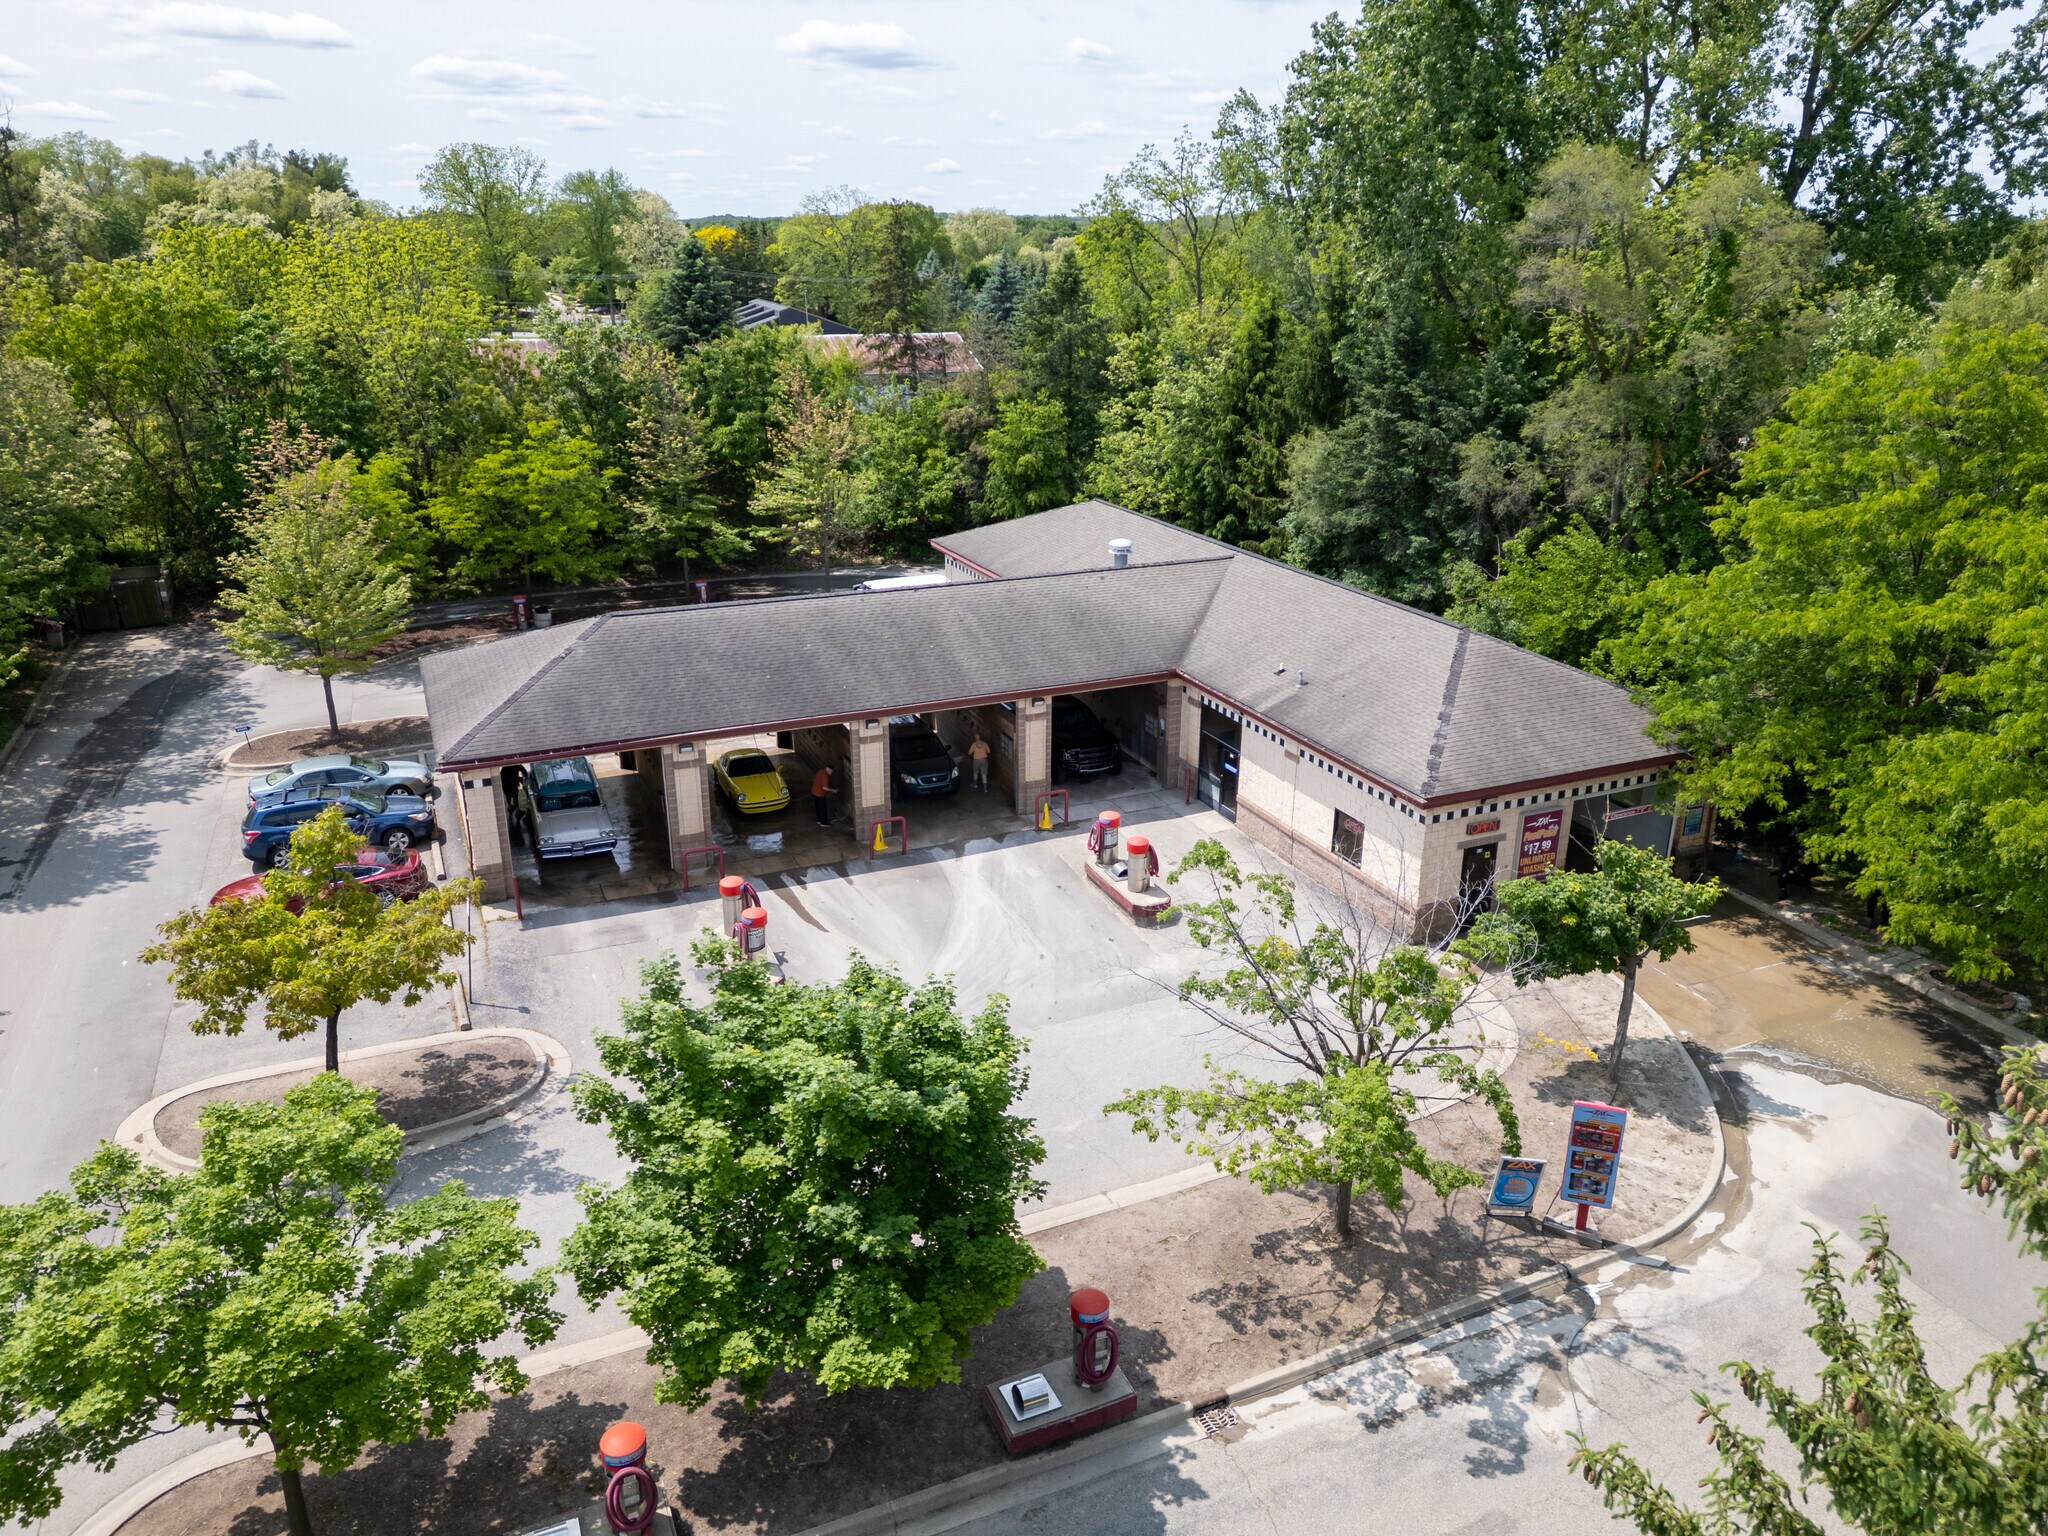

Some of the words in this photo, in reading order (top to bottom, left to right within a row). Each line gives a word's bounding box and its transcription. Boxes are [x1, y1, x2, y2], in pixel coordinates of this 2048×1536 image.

[1344, 818, 1364, 834] OPEN
[1471, 820, 1497, 835] OPEN
[1524, 840, 1551, 855] $17.99
[1520, 852, 1555, 867] UNLIMITED
[1523, 862, 1547, 874] WASHE
[1507, 1160, 1536, 1171] ZAX
